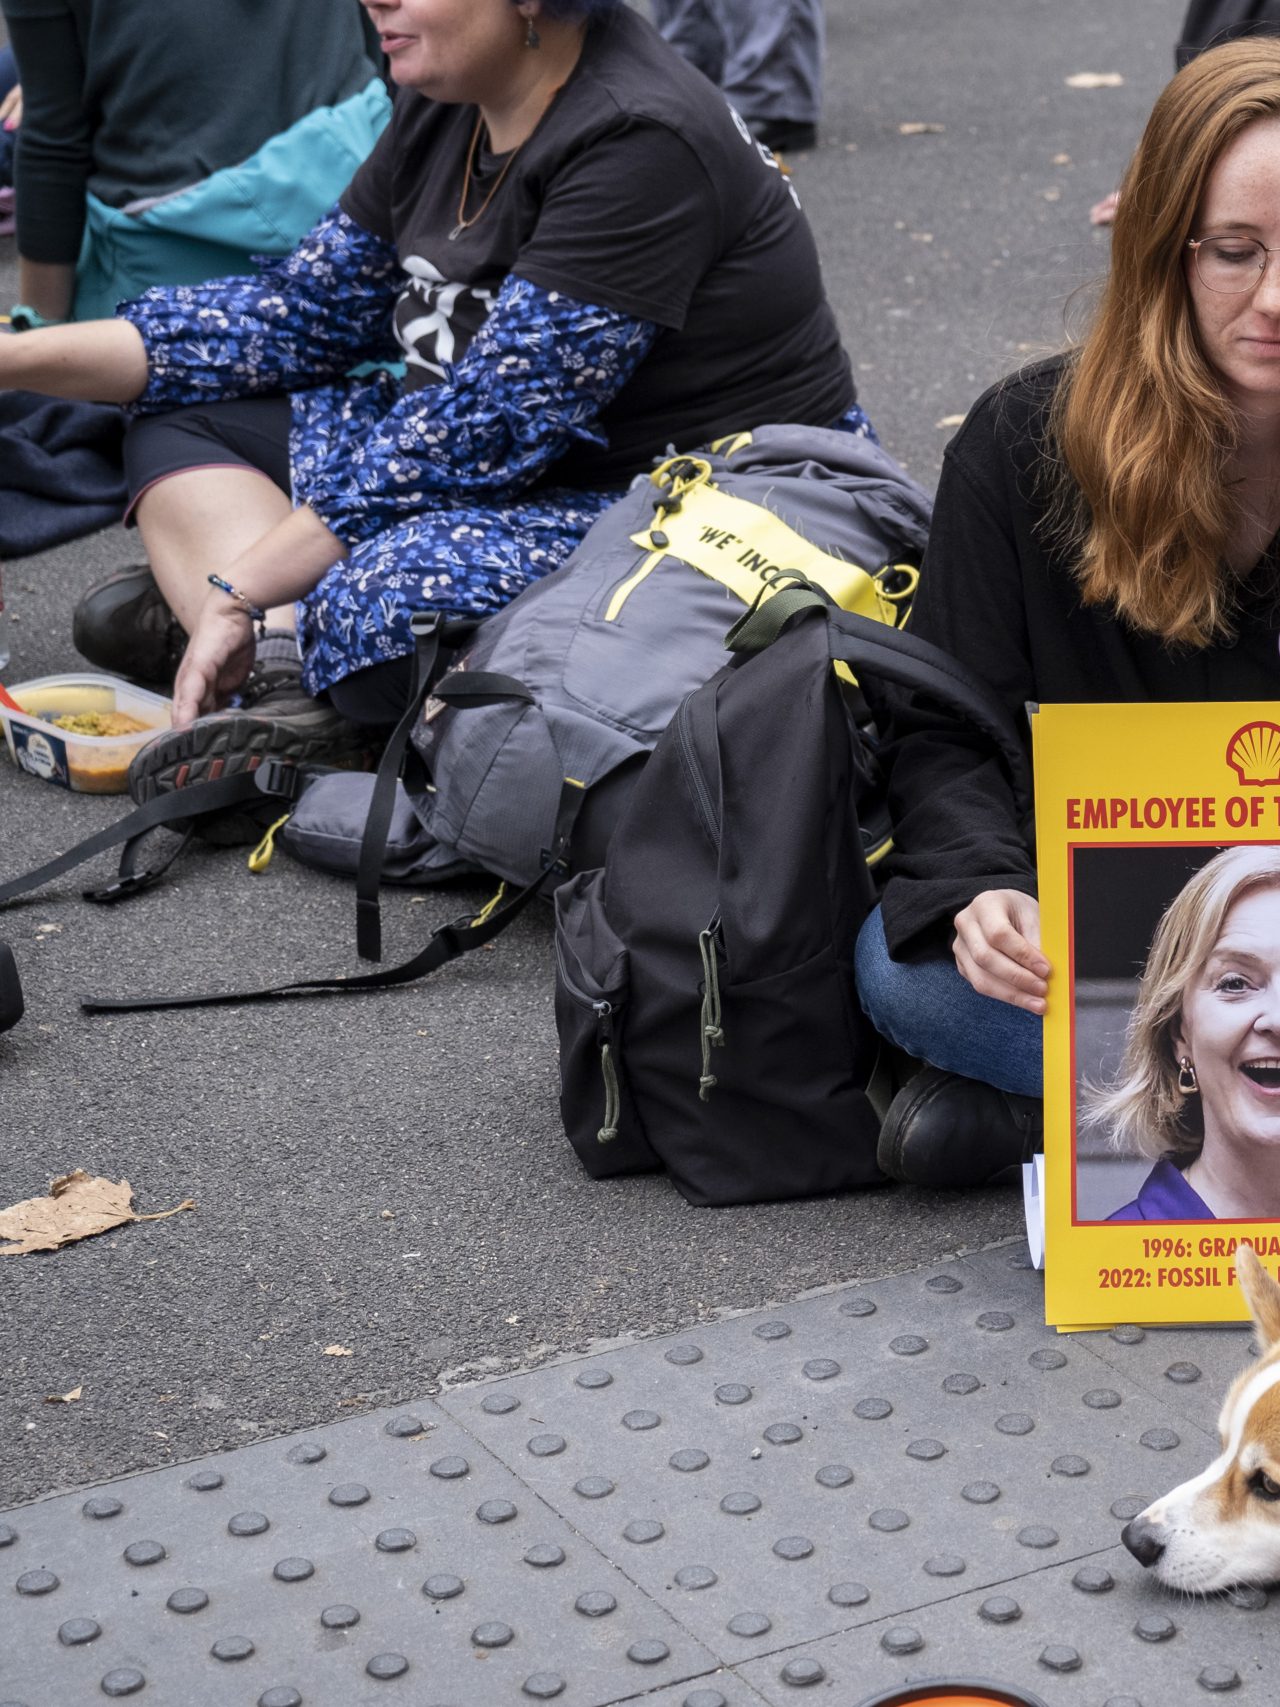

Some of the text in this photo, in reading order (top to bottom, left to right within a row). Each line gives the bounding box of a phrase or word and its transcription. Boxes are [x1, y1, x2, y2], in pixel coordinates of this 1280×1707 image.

[1066, 797, 1216, 829] EMPLOYEE
[1225, 796, 1264, 828] OF
[1143, 1238, 1192, 1258] 1996:
[1099, 1268, 1151, 1288] 2022:
[1158, 1266, 1221, 1287] FOSSIL
